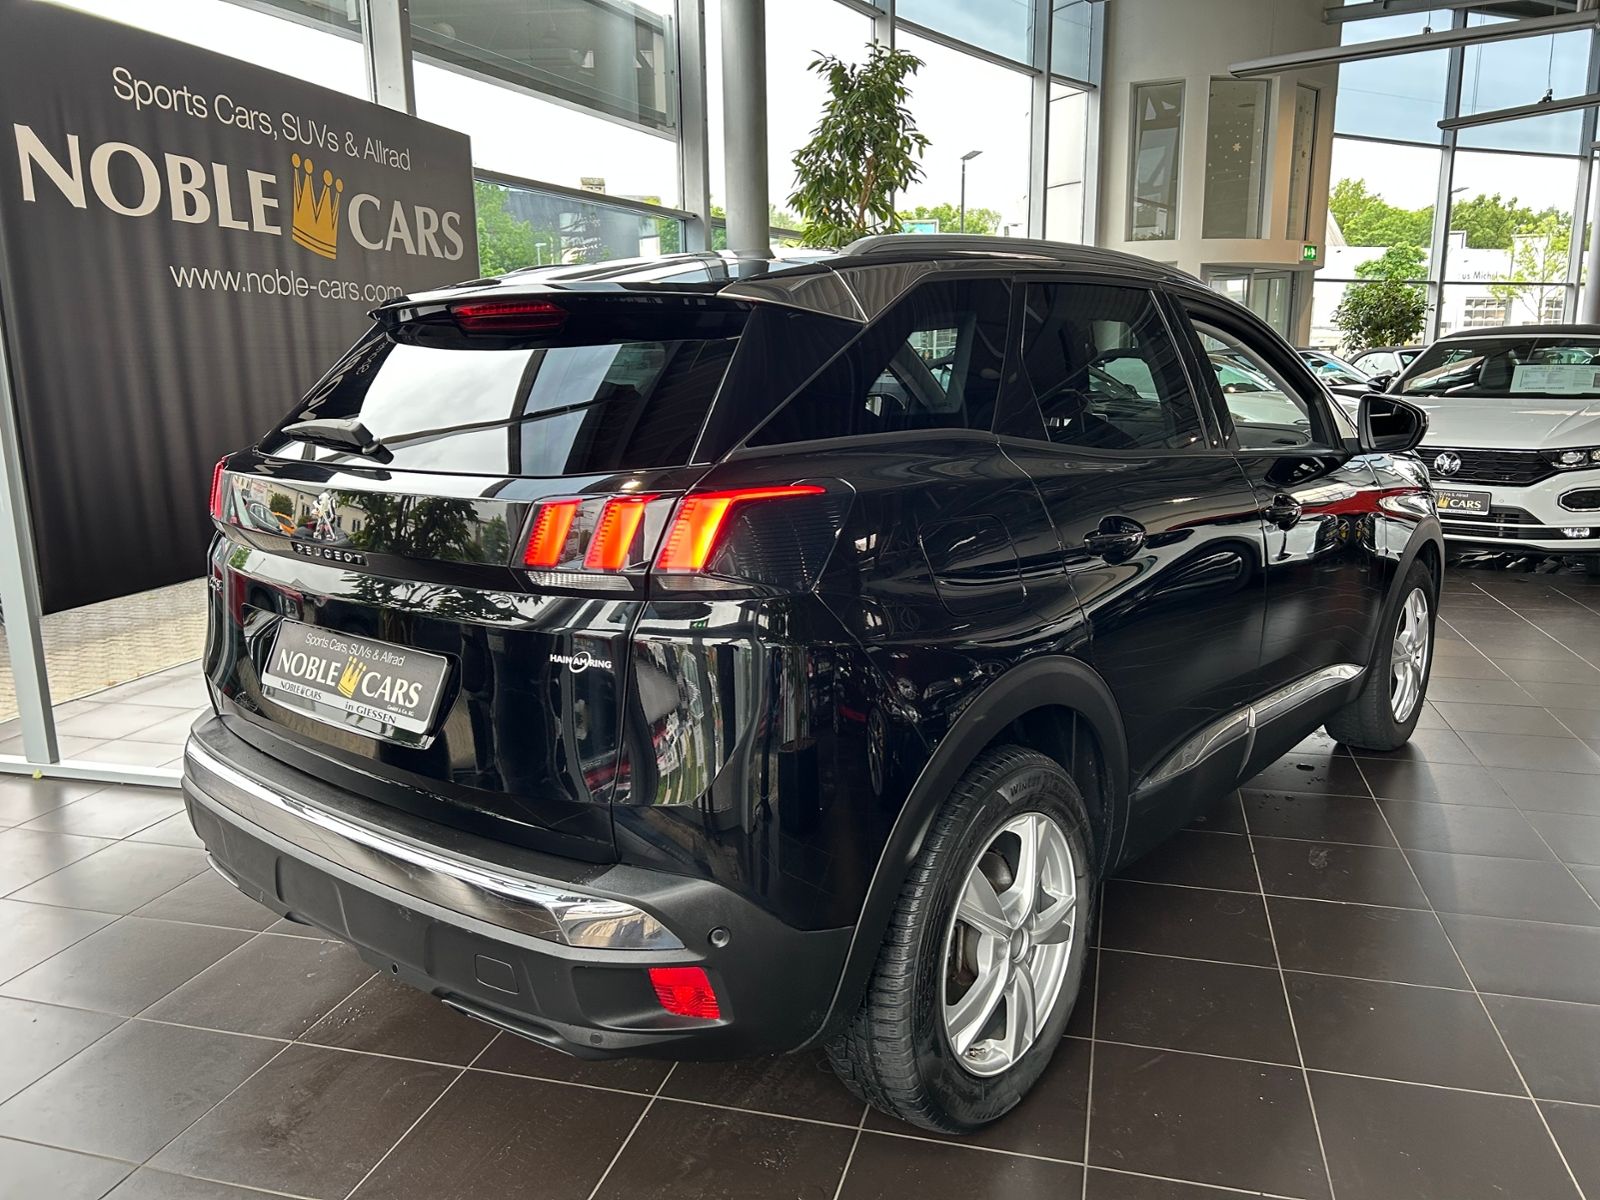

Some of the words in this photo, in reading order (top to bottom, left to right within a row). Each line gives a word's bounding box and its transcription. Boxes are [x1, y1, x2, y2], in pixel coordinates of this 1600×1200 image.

[112, 66, 208, 118] Sports
[214, 94, 278, 141] Cars,
[281, 112, 339, 152] SUVs
[344, 131, 359, 158] &
[363, 137, 411, 172] Allrad
[13, 123, 282, 236] NOBLE
[347, 193, 465, 261] CARS
[169, 265, 404, 302] www.noble-cars.com
[1449, 499, 1482, 510] CARS
[296, 543, 363, 564] PEUGEOT
[305, 632, 329, 648] Sports
[329, 638, 348, 655] Cars,
[348, 643, 371, 658] SUVs
[372, 649, 380, 661] &
[380, 650, 406, 667] Allrad
[276, 648, 342, 687] NOBLE
[361, 671, 423, 709] CARS
[280, 680, 301, 694] NOBLE
[305, 688, 322, 701] CARS
[345, 701, 354, 710] in
[356, 705, 397, 725] GIESSEN
